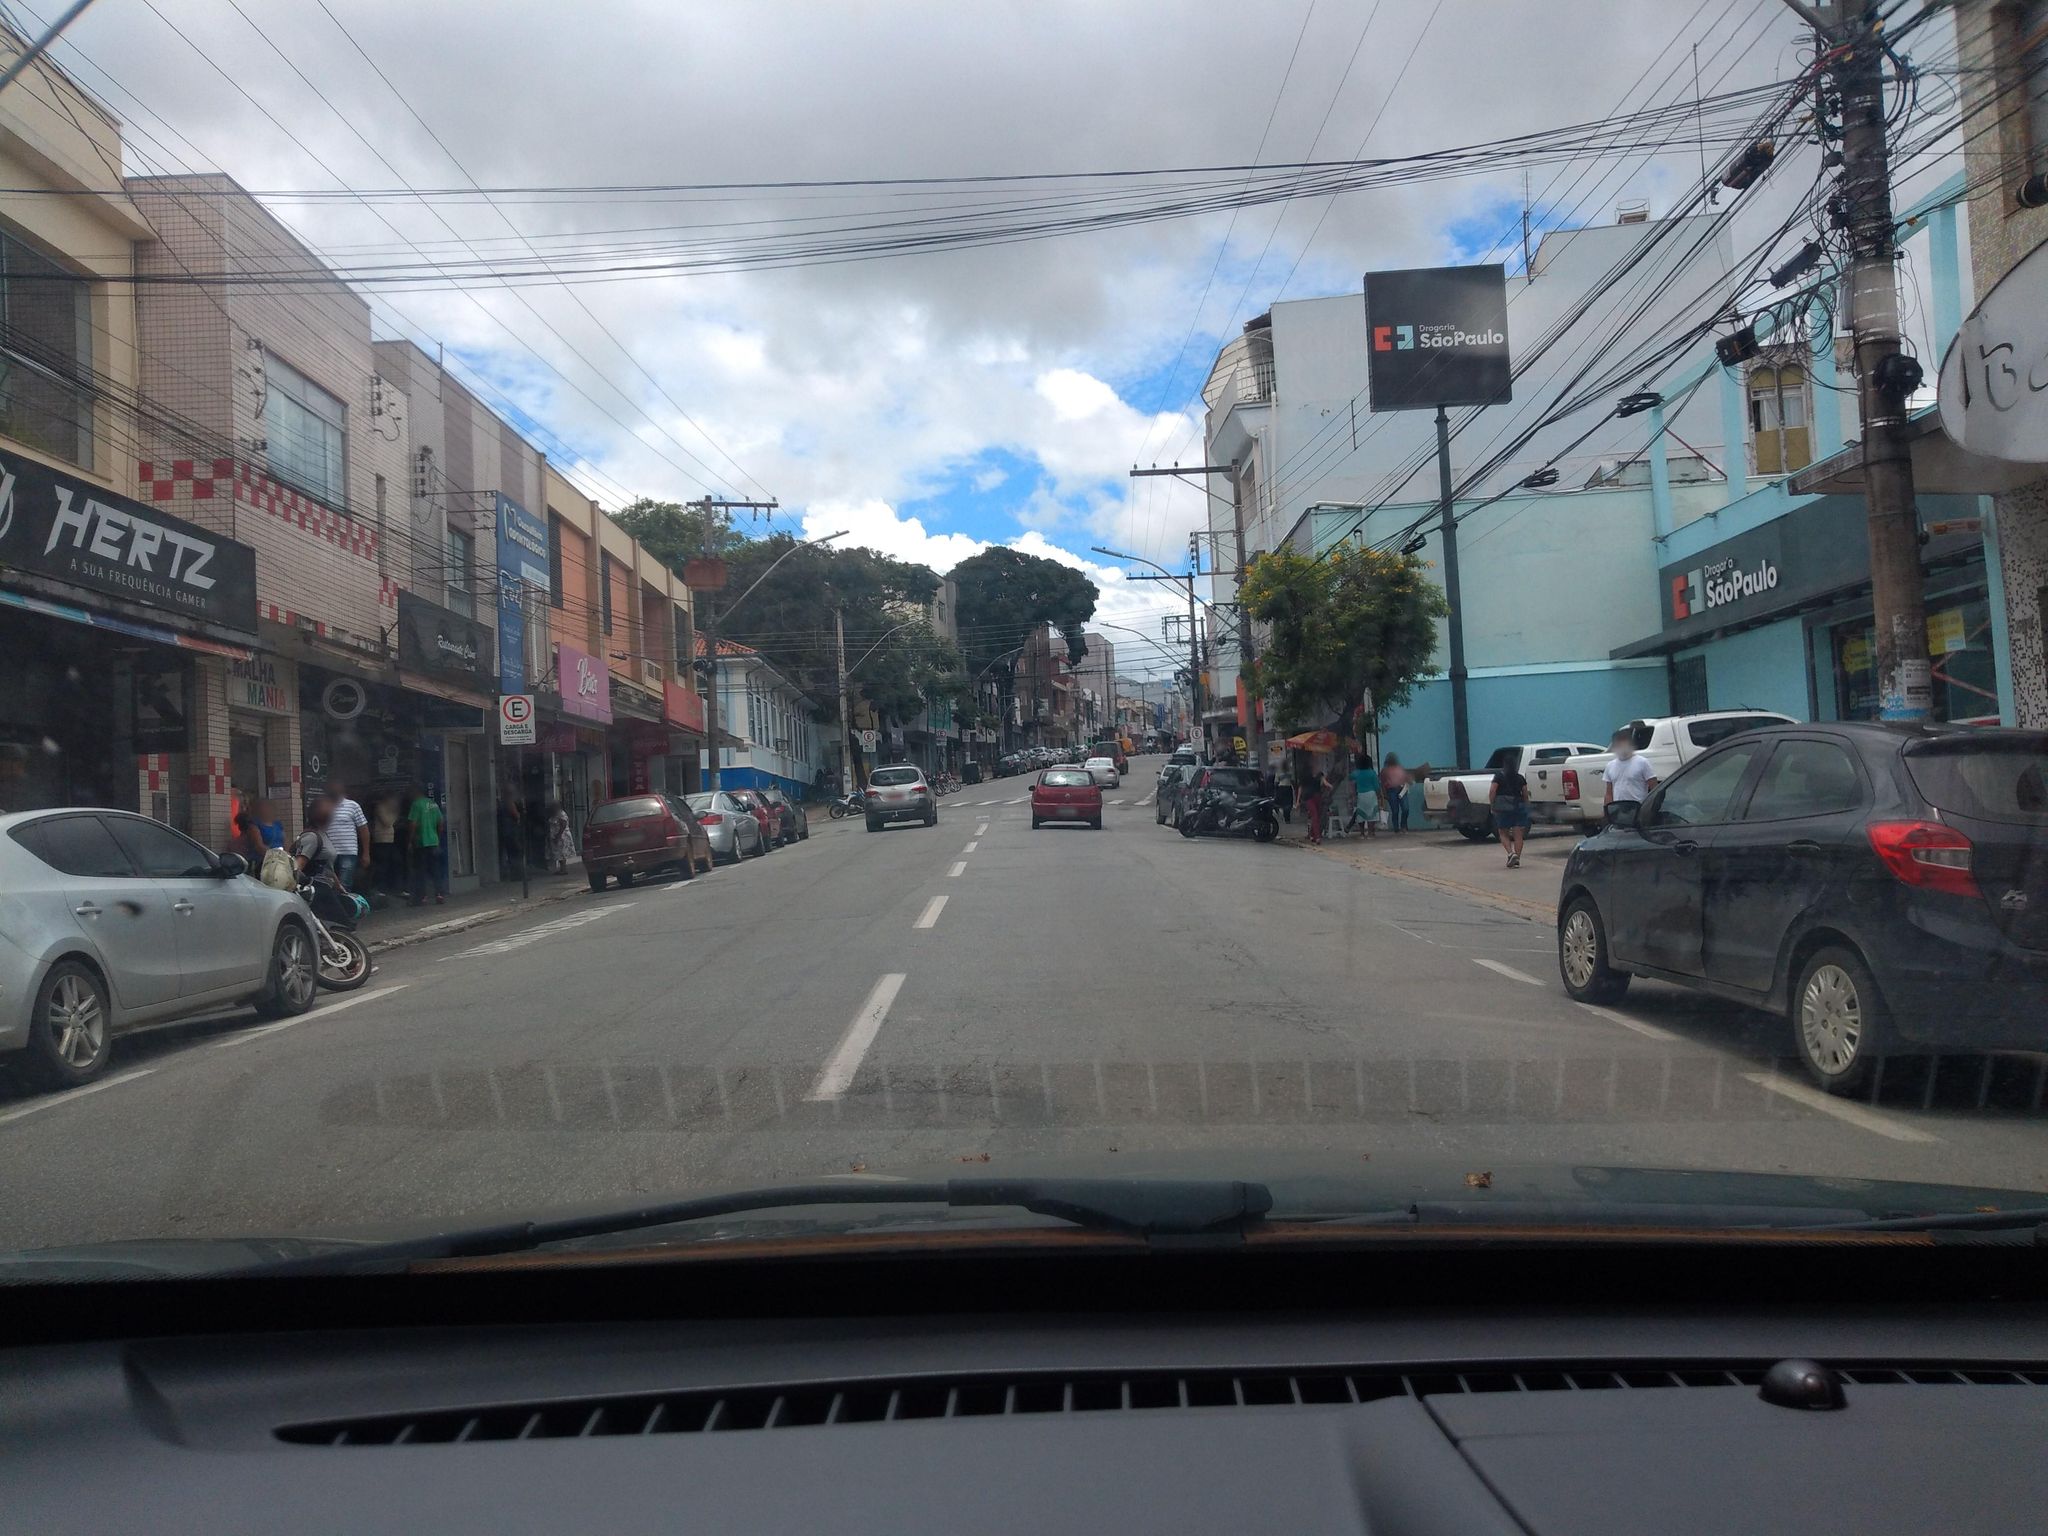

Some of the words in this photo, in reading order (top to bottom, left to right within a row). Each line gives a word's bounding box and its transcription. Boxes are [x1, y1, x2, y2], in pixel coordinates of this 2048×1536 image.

[1419, 324, 1456, 333] Drogaria
[43, 484, 217, 590] HERTZ
[70, 558, 77, 570] A
[82, 562, 104, 579] SUA
[109, 569, 171, 599] FREQUÊNCIA
[175, 590, 206, 609] GAMER
[232, 661, 276, 685] MALHA
[247, 682, 288, 711] MANIA
[511, 701, 523, 717] E
